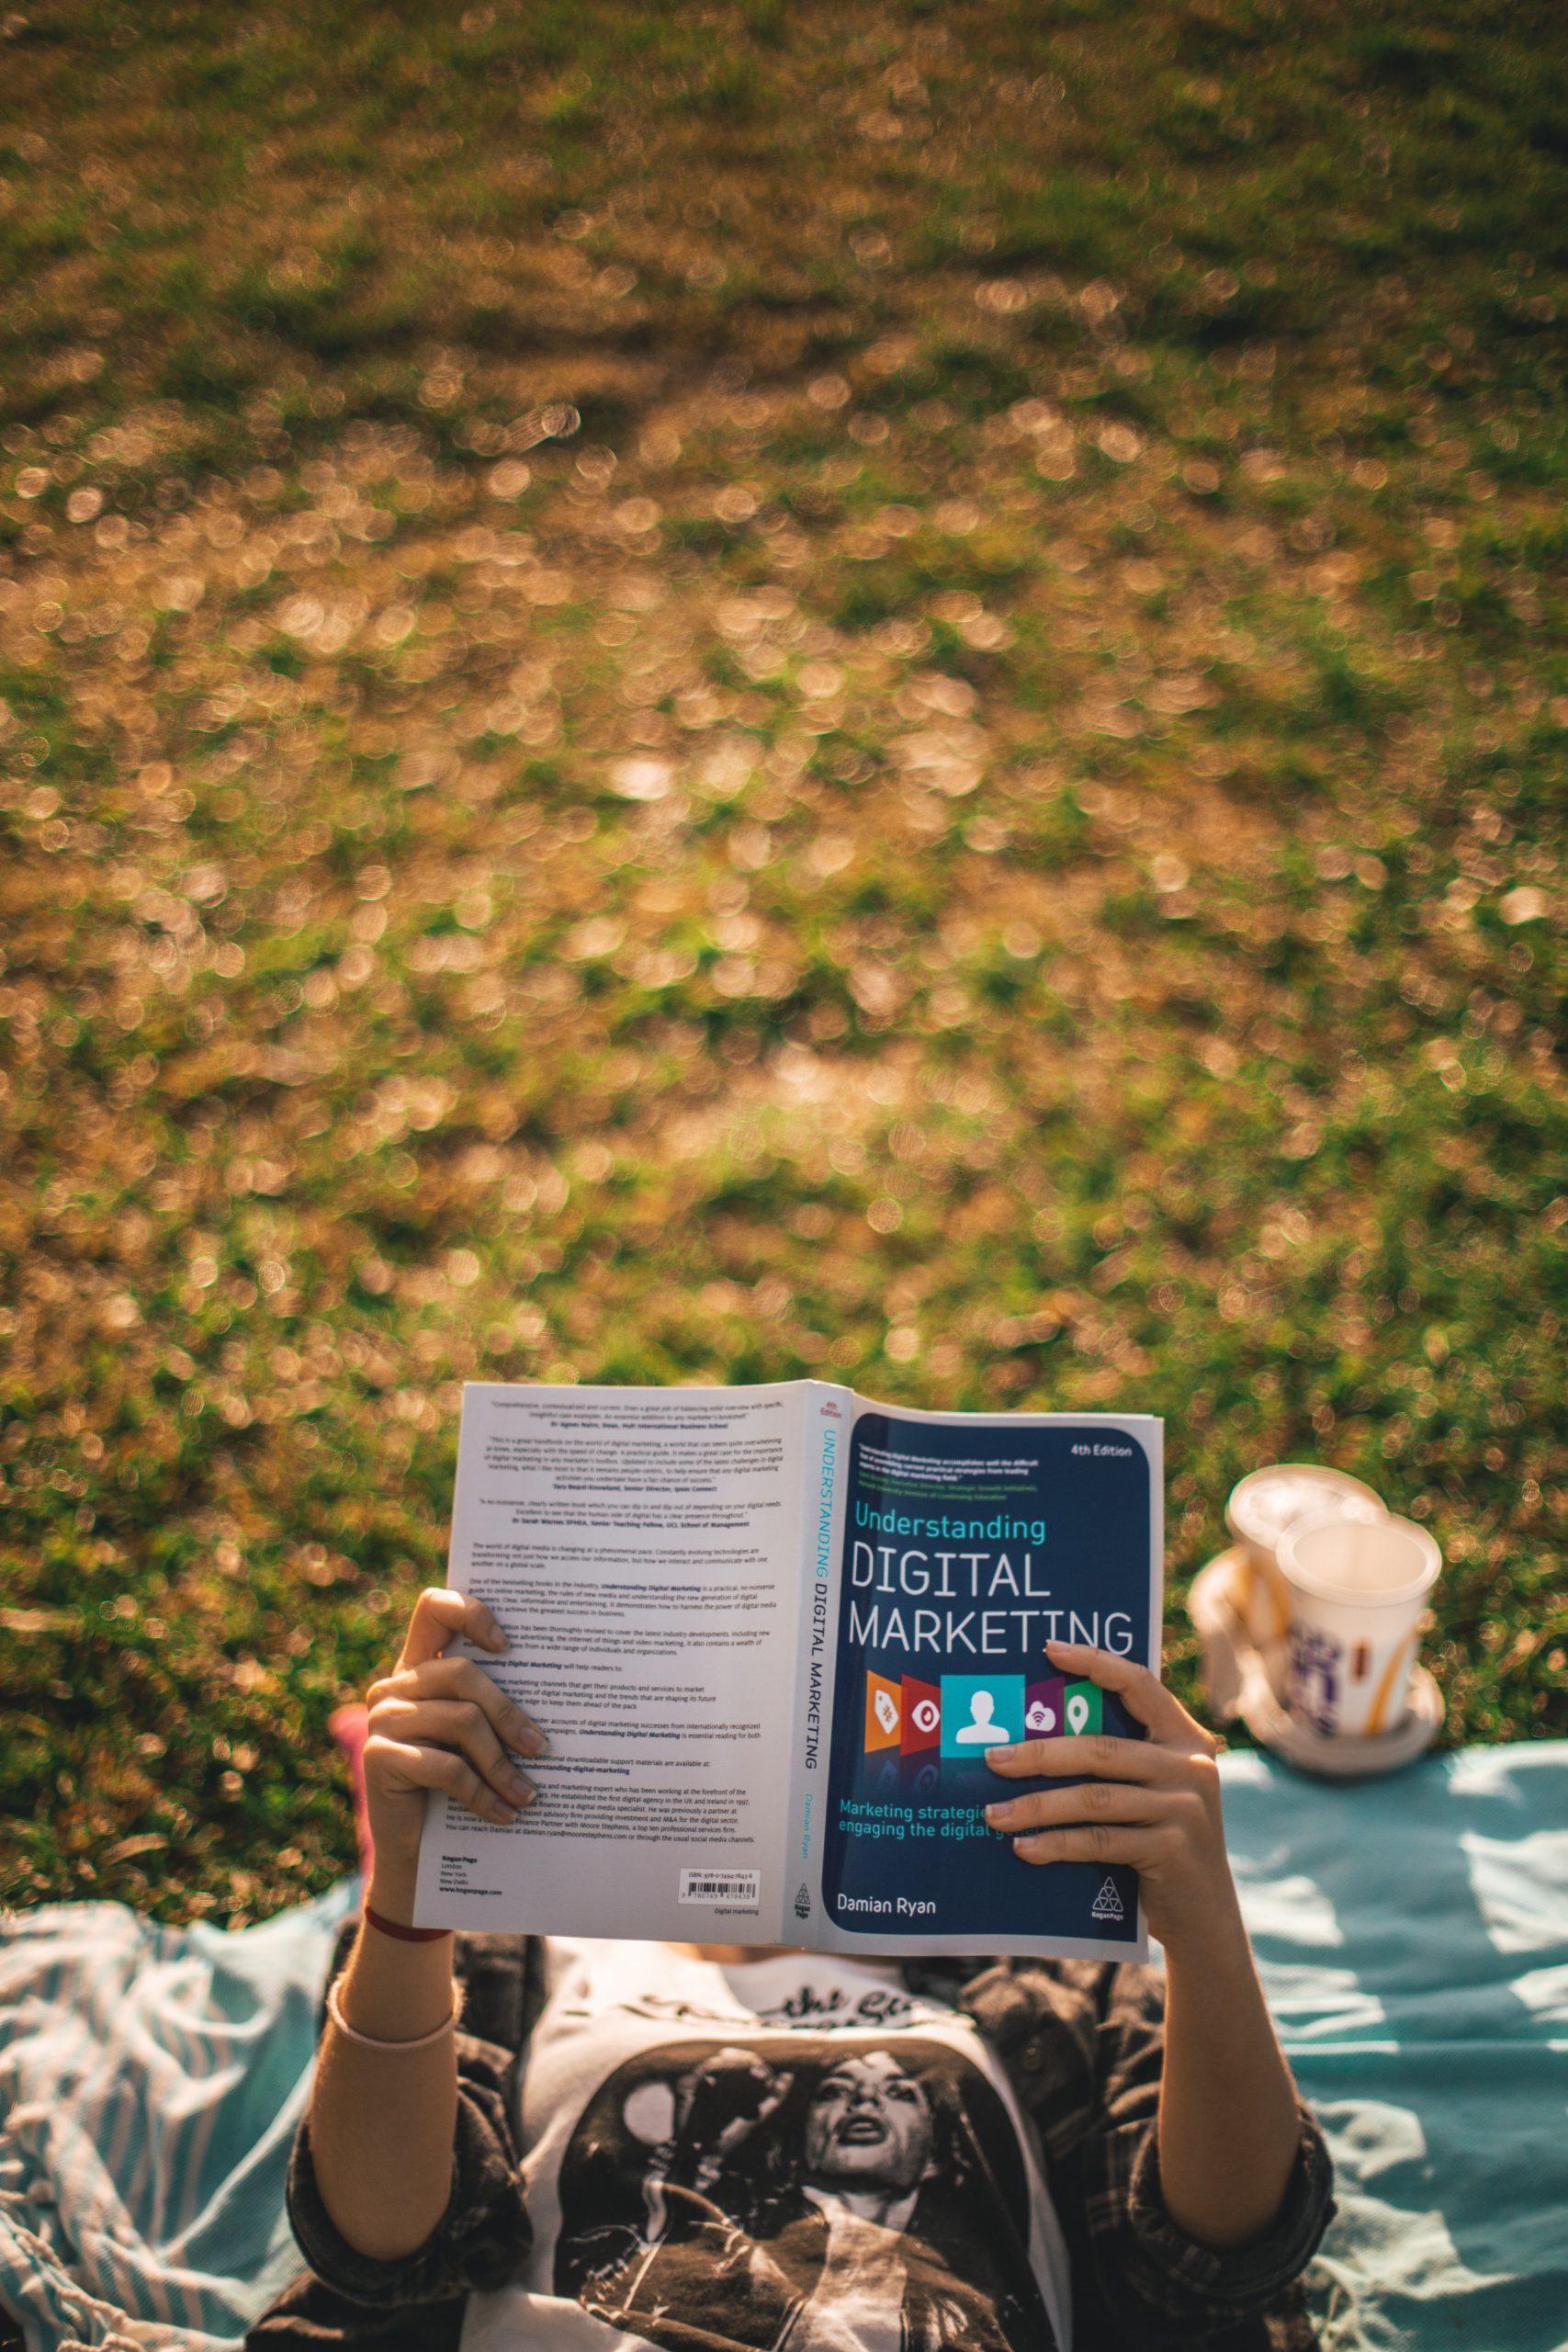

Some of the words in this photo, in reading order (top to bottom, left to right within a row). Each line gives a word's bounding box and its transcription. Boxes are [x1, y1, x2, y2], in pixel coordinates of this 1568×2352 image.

[1071, 1443, 1091, 1455] 4th
[1093, 1444, 1133, 1456] Edition
[816, 1429, 836, 1578] UNDERSTANDING
[855, 1501, 1046, 1545] Understanding
[851, 1541, 1051, 1597] DIGITAL
[811, 1583, 828, 1656] DIGITAL
[849, 1600, 1133, 1655] MARKETING
[806, 1662, 823, 1769] MARKETING
[839, 1821, 905, 1840] engaging
[909, 1823, 936, 1837] the
[941, 1822, 990, 1840] digital
[840, 1798, 913, 1822] Marketing
[918, 1804, 987, 1823] strategie
[439, 1886, 502, 1896] www.koganpage.com
[838, 1894, 892, 1913] Damian
[897, 1897, 936, 1917] Ryan
